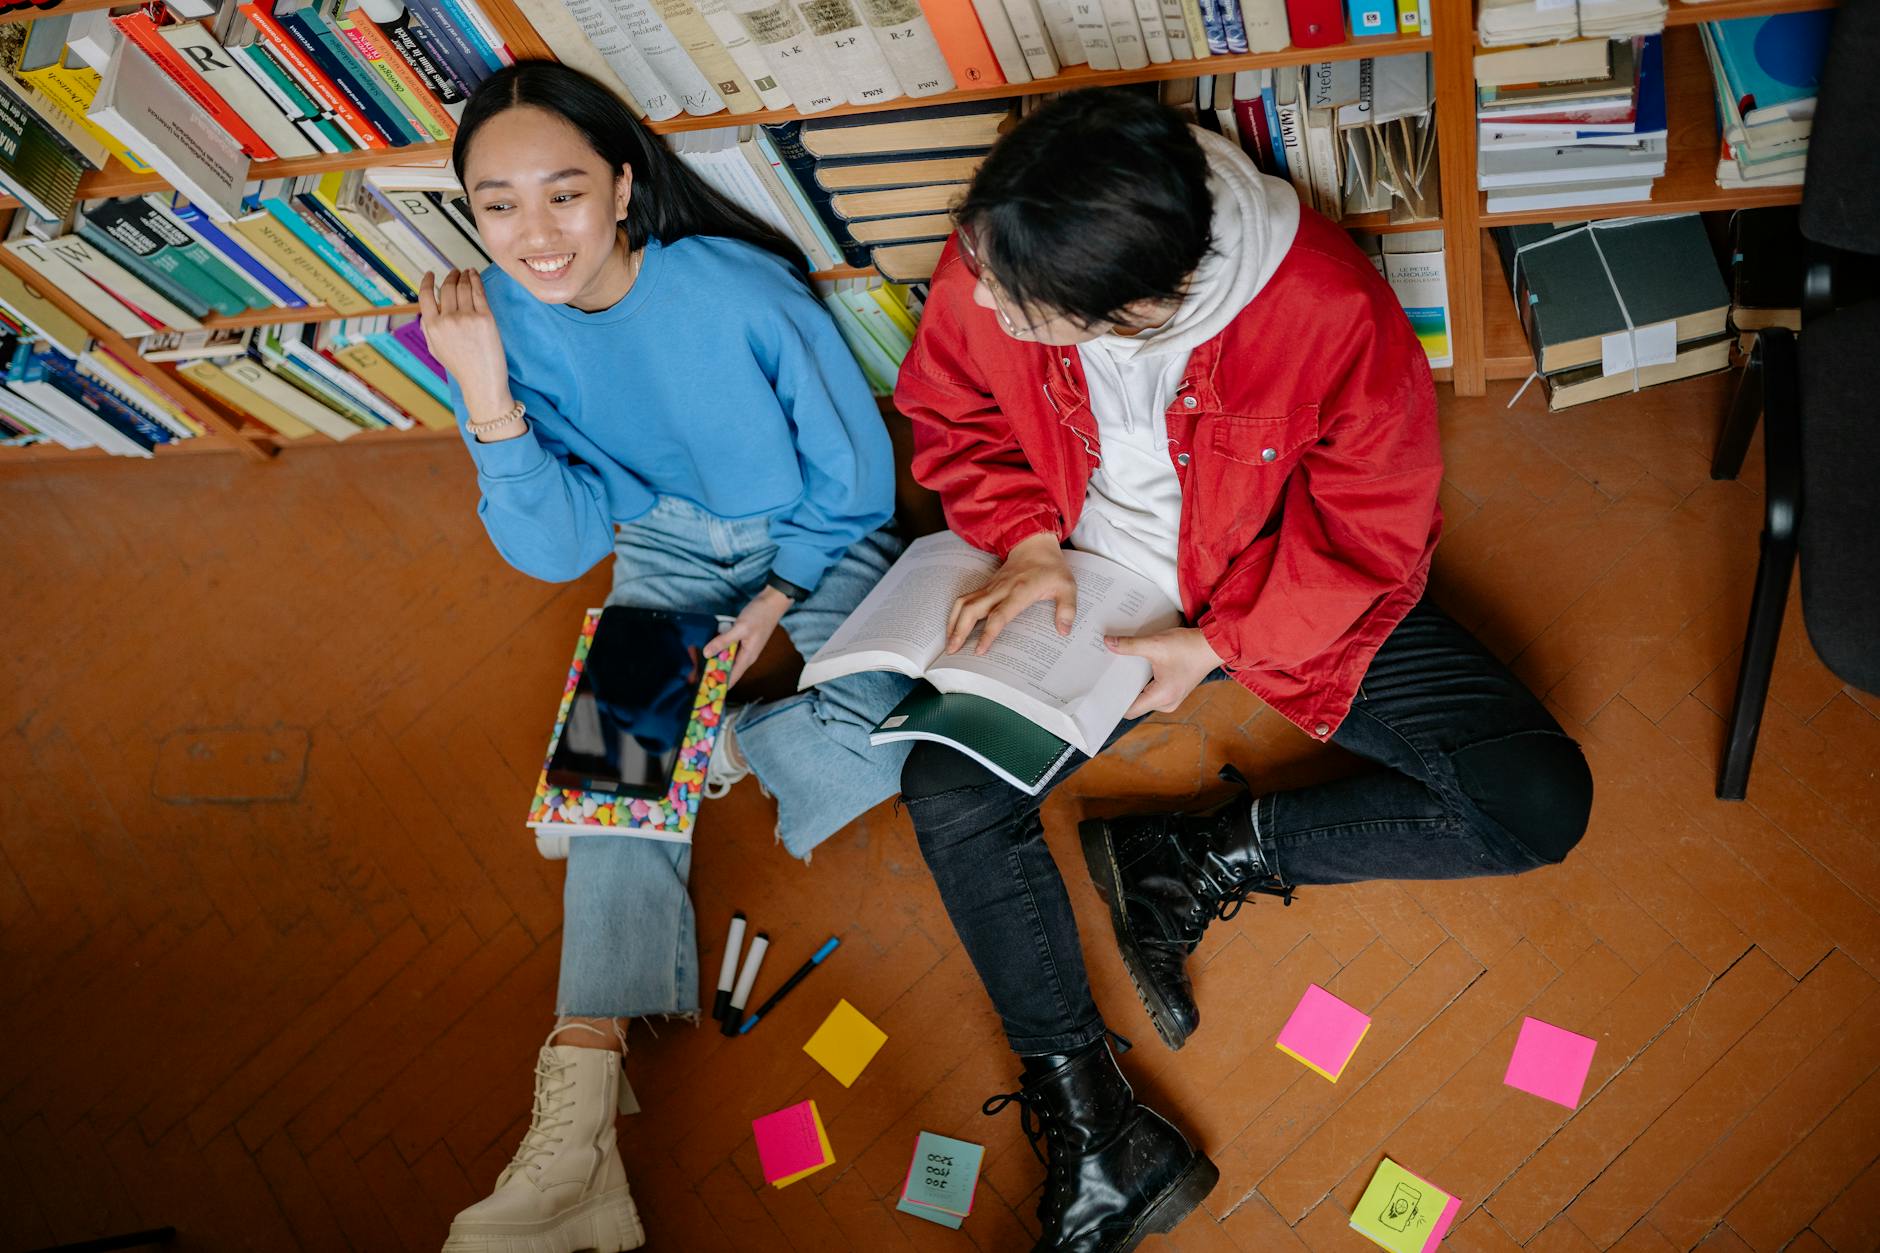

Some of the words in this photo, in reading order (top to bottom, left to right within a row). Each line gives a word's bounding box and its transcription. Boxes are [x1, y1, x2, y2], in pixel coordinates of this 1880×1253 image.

[251, 11, 282, 43] Grammatik
[447, 27, 457, 37] und
[358, 34, 381, 58] DUDEN
[393, 26, 416, 50] Zürich
[179, 45, 230, 72] R
[280, 42, 305, 68] deutsche
[410, 47, 421, 58] in
[302, 66, 318, 82] Neue
[417, 55, 436, 76] Mann
[376, 62, 405, 93] Ökologie
[431, 73, 455, 99] Thomas
[723, 83, 735, 93] 2
[917, 80, 939, 90] PWN
[1316, 61, 1332, 105] Учебн
[811, 96, 832, 107] PWN
[861, 88, 884, 98] PWN
[1278, 105, 1298, 150] TUWIM
[400, 198, 430, 216] B
[53, 242, 93, 264] W
[237, 365, 261, 383] D
